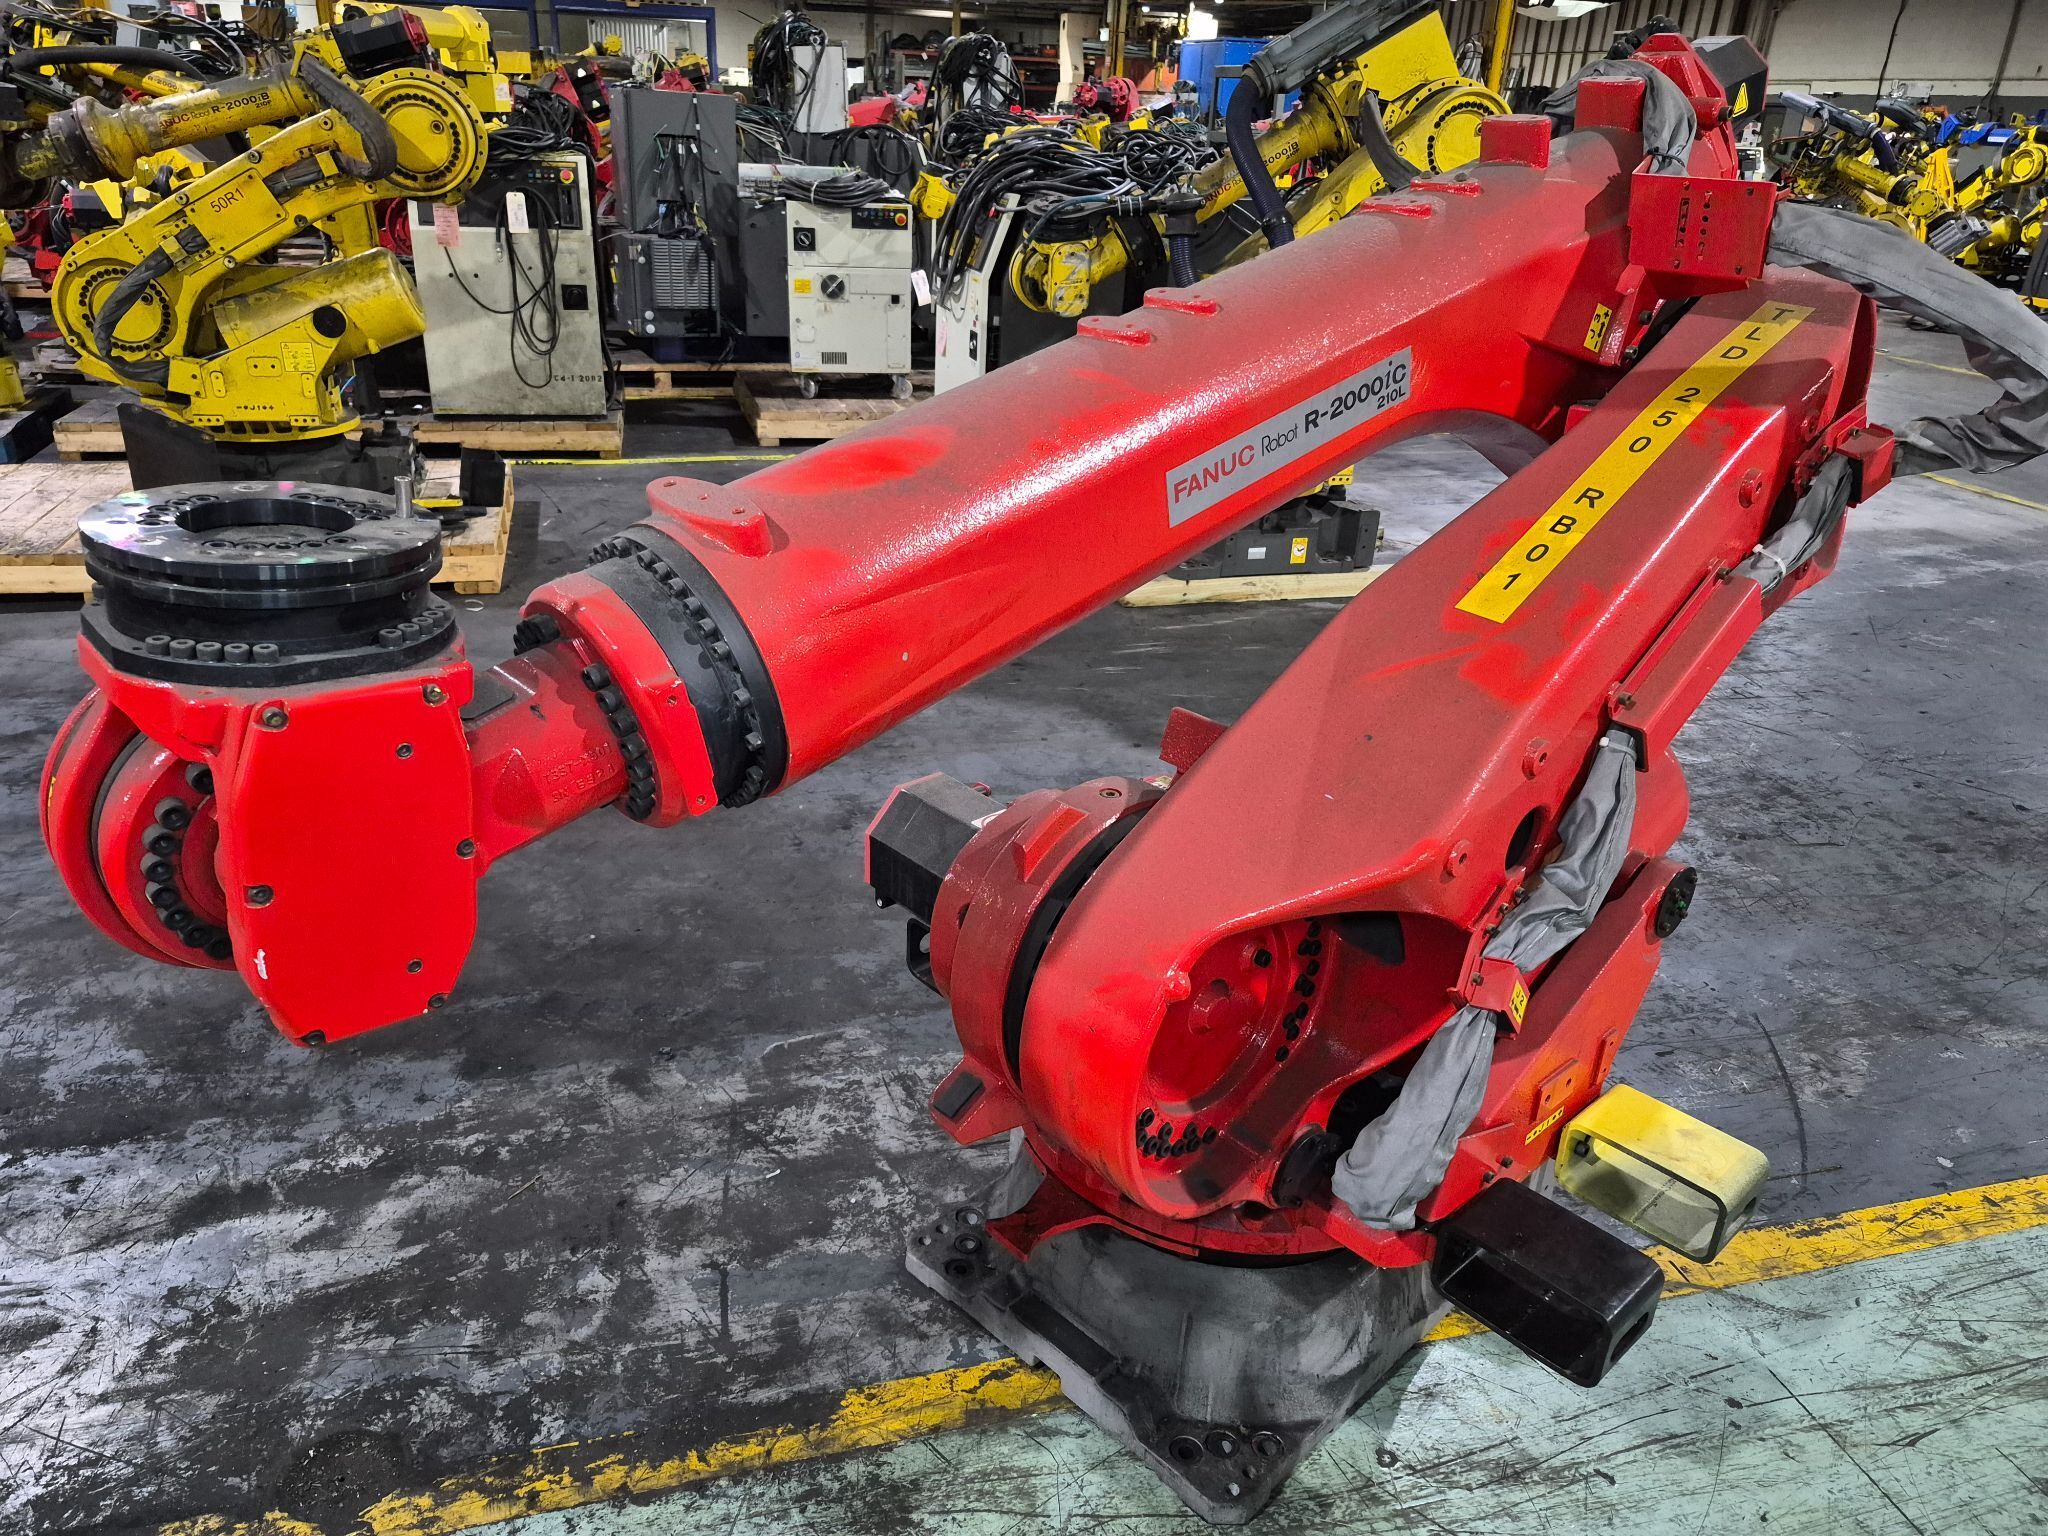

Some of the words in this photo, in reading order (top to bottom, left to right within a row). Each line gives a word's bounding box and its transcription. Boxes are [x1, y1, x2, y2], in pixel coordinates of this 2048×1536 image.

[211, 92, 269, 113] R-2000iB
[210, 187, 244, 213] 50R1
[1376, 386, 1407, 410] 210L
[1173, 444, 1255, 504] FANUC
[1261, 423, 1299, 457] Robot
[1304, 360, 1407, 434] R-2000iC
